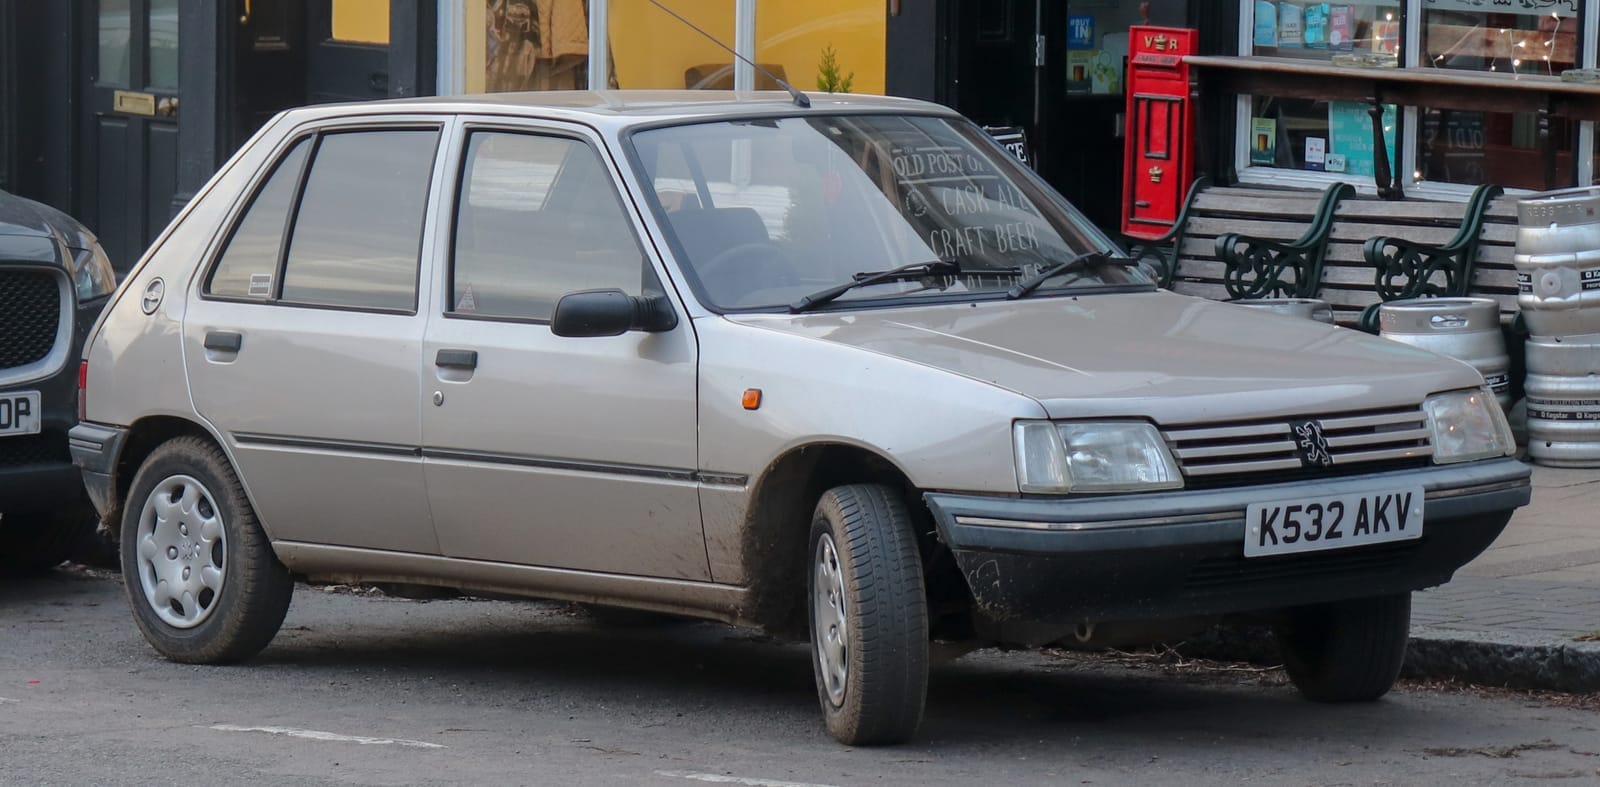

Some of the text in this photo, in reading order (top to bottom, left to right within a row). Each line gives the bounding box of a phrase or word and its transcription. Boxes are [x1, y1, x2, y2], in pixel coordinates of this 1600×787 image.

[1144, 35, 1178, 49] V R
[894, 154, 924, 176] OLD
[927, 152, 963, 174] POST
[942, 185, 990, 215] CASK
[930, 222, 1040, 257] CRAFT BEER
[1259, 492, 1412, 547] K532 AKV
